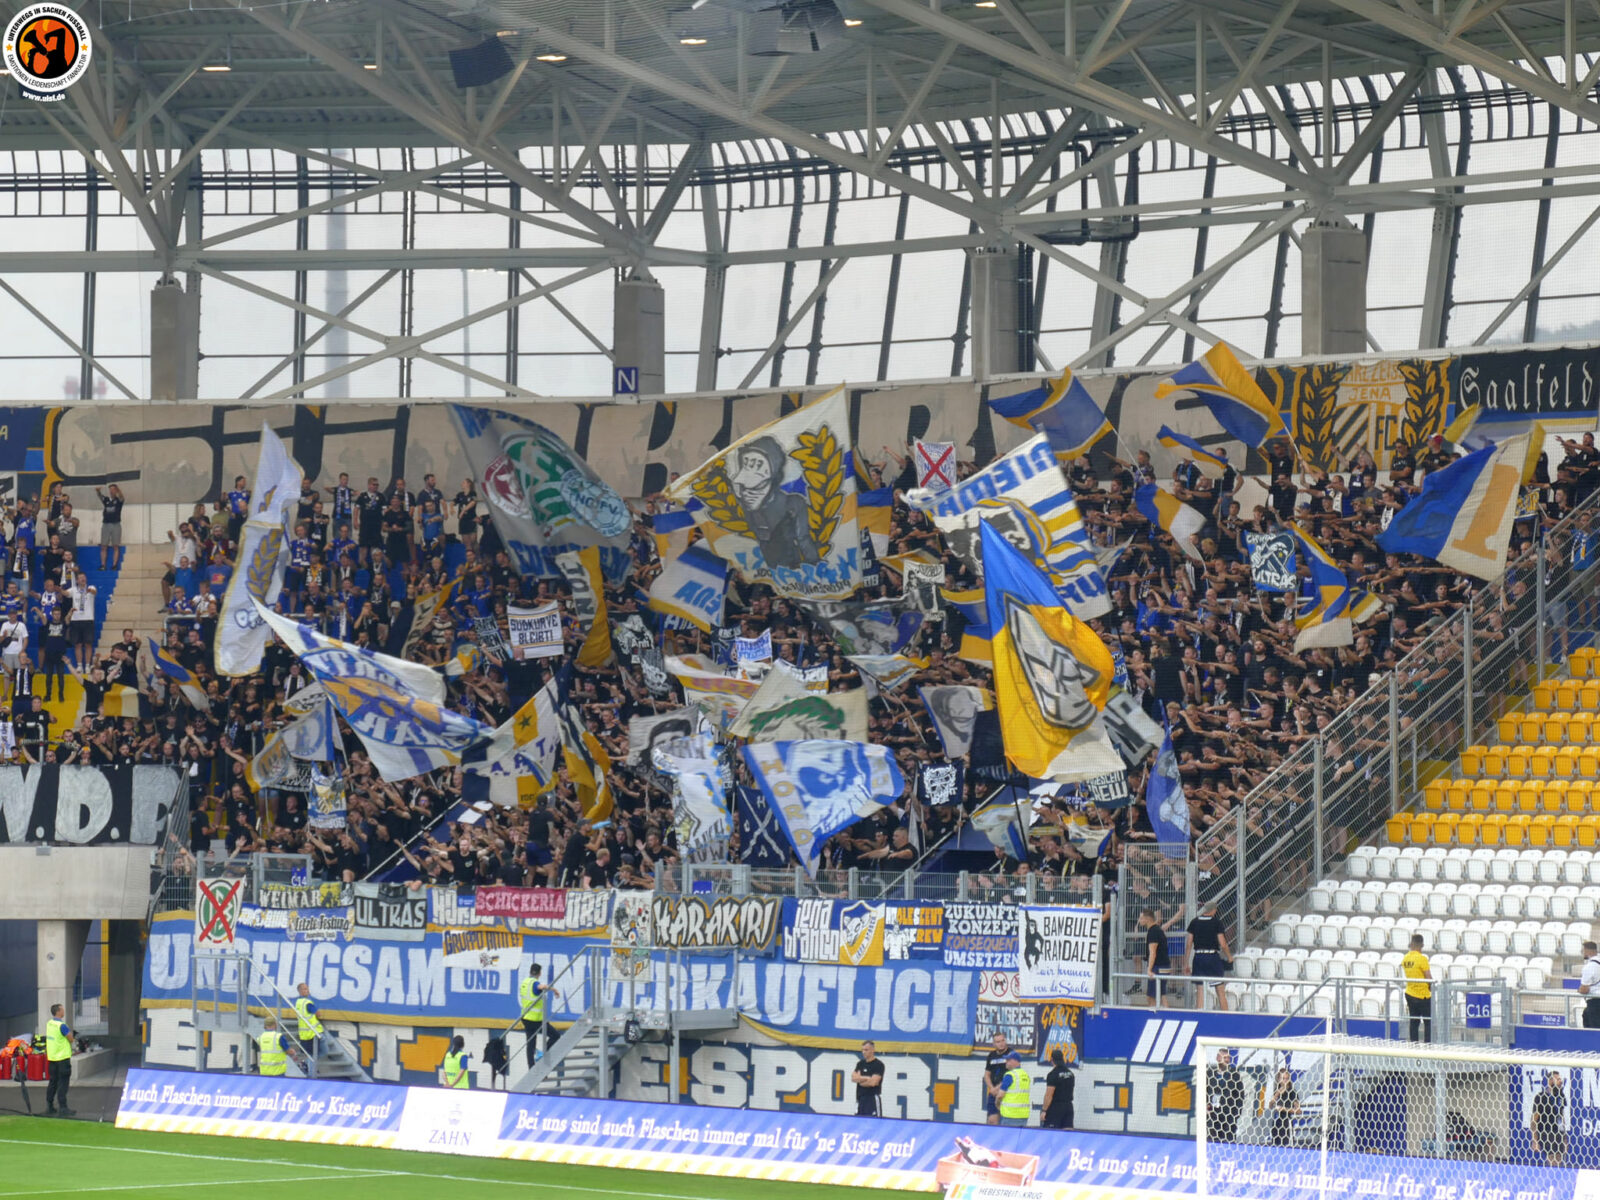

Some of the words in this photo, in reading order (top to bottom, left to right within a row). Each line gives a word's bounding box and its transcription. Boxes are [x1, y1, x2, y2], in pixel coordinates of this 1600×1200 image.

[618, 369, 635, 391] N
[1459, 361, 1592, 413] Saalfeld
[1348, 387, 1391, 401] JENA
[1375, 415, 1397, 450] FC
[1252, 567, 1297, 590] ULTRAS
[259, 888, 321, 909] WEIMAR
[476, 892, 566, 913] SCHICKERIA
[356, 897, 426, 928] ULTRAS
[652, 896, 774, 949] HARAKIRI
[948, 919, 1020, 936] KONZEPT
[945, 935, 1020, 953] KONSEQUENT
[149, 933, 446, 1006] UNBEUGSAM
[943, 949, 1020, 969] UMSETZEN
[463, 968, 500, 991] UND
[976, 1003, 1035, 1024] REFUGEES
[1466, 1004, 1490, 1018] C16
[1048, 1029, 1058, 1042] IN
[1059, 1029, 1072, 1043] DIE
[130, 1085, 158, 1103] auch
[161, 1084, 211, 1107] Flaschen
[214, 1089, 254, 1109] immer
[256, 1091, 281, 1111] mal
[281, 1092, 302, 1113] für
[327, 1095, 362, 1117] Kiste
[363, 1099, 392, 1124] gut!
[428, 1129, 472, 1146] ZAHN
[515, 1109, 539, 1131] Bei
[542, 1115, 568, 1133] uns
[570, 1114, 601, 1135] sind
[602, 1117, 636, 1139] auch
[638, 1118, 699, 1142] Flaschen
[703, 1125, 751, 1146] immer
[752, 1127, 782, 1149] mal
[784, 1128, 810, 1151] für
[838, 1132, 880, 1156] Kiste
[882, 1137, 916, 1163] gut!
[1067, 1148, 1094, 1172] Bei
[1099, 1153, 1129, 1174] uns
[1132, 1154, 1170, 1177] sind
[1215, 1160, 1290, 1190] Flaschen
[1295, 1170, 1353, 1196] immer
[1355, 1173, 1390, 1198] mal
[1394, 1173, 1425, 1200] für
[1463, 1180, 1511, 1200] Kiste
